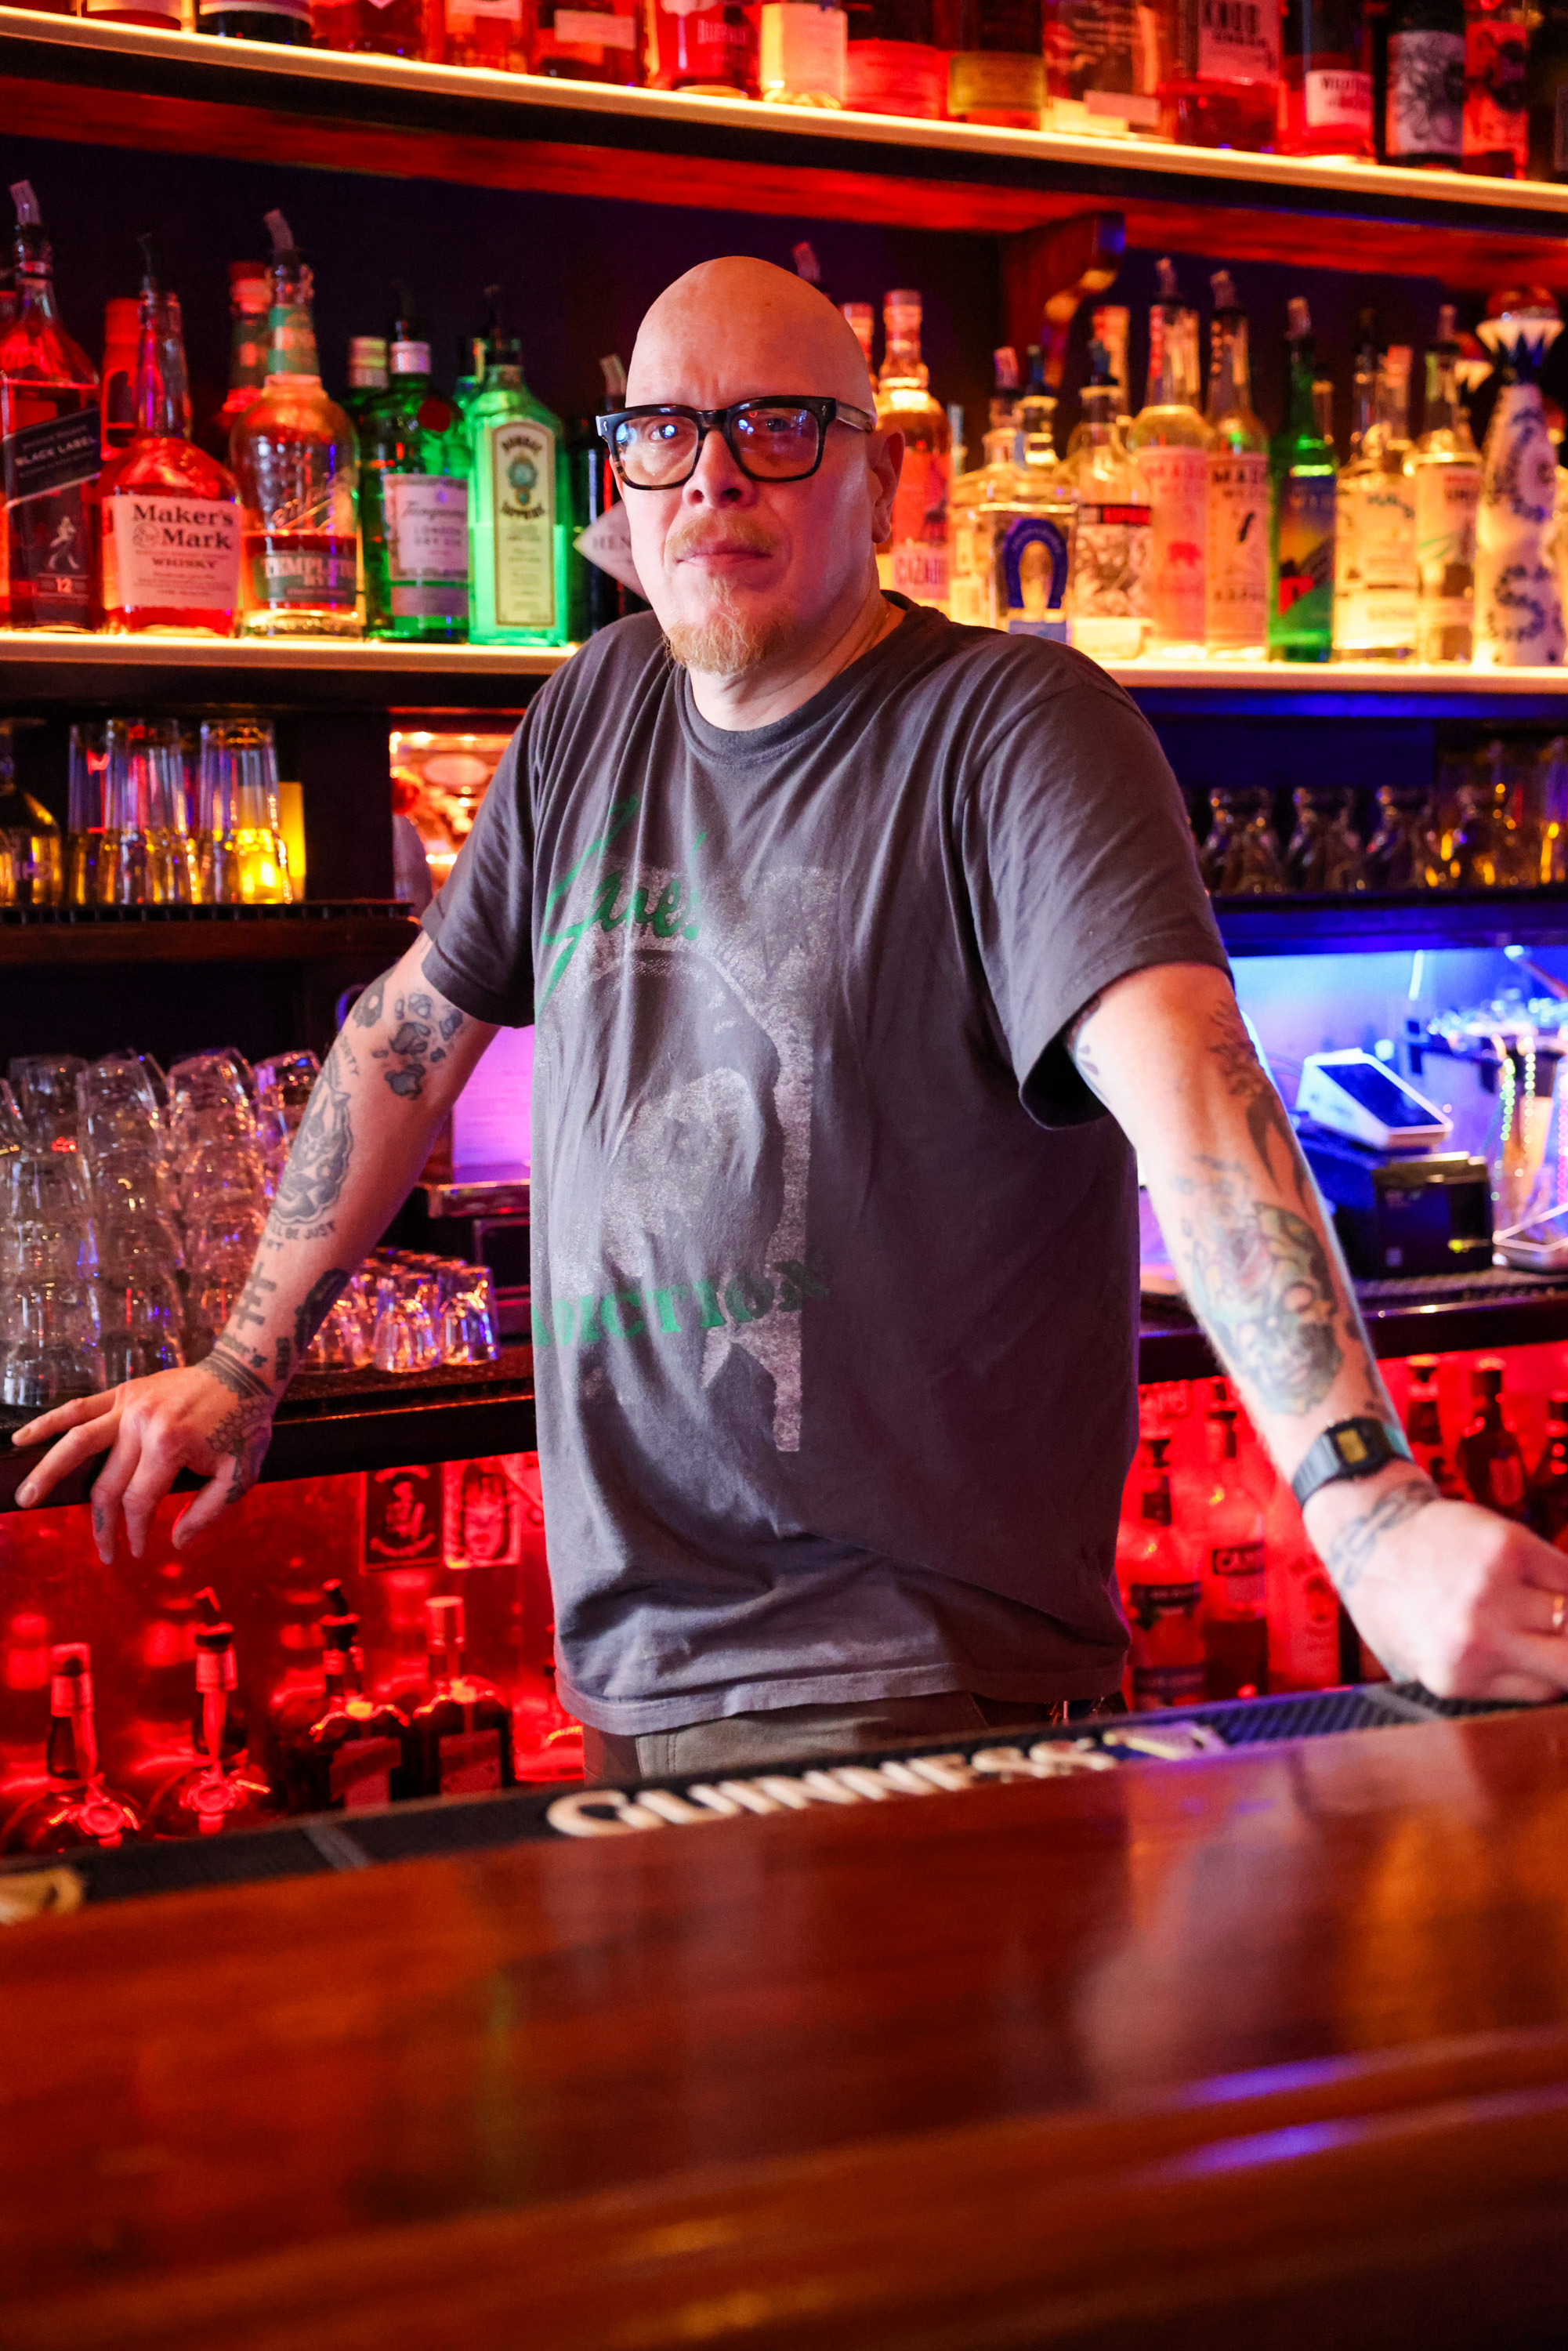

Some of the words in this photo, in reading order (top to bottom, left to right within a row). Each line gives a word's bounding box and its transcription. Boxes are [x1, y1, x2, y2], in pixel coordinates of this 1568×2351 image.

[57, 436, 98, 455] LABEL
[133, 503, 234, 527] Maker's
[161, 528, 233, 551] Mark
[56, 578, 72, 593] 12
[547, 1737, 1117, 1838] GUINNESS
